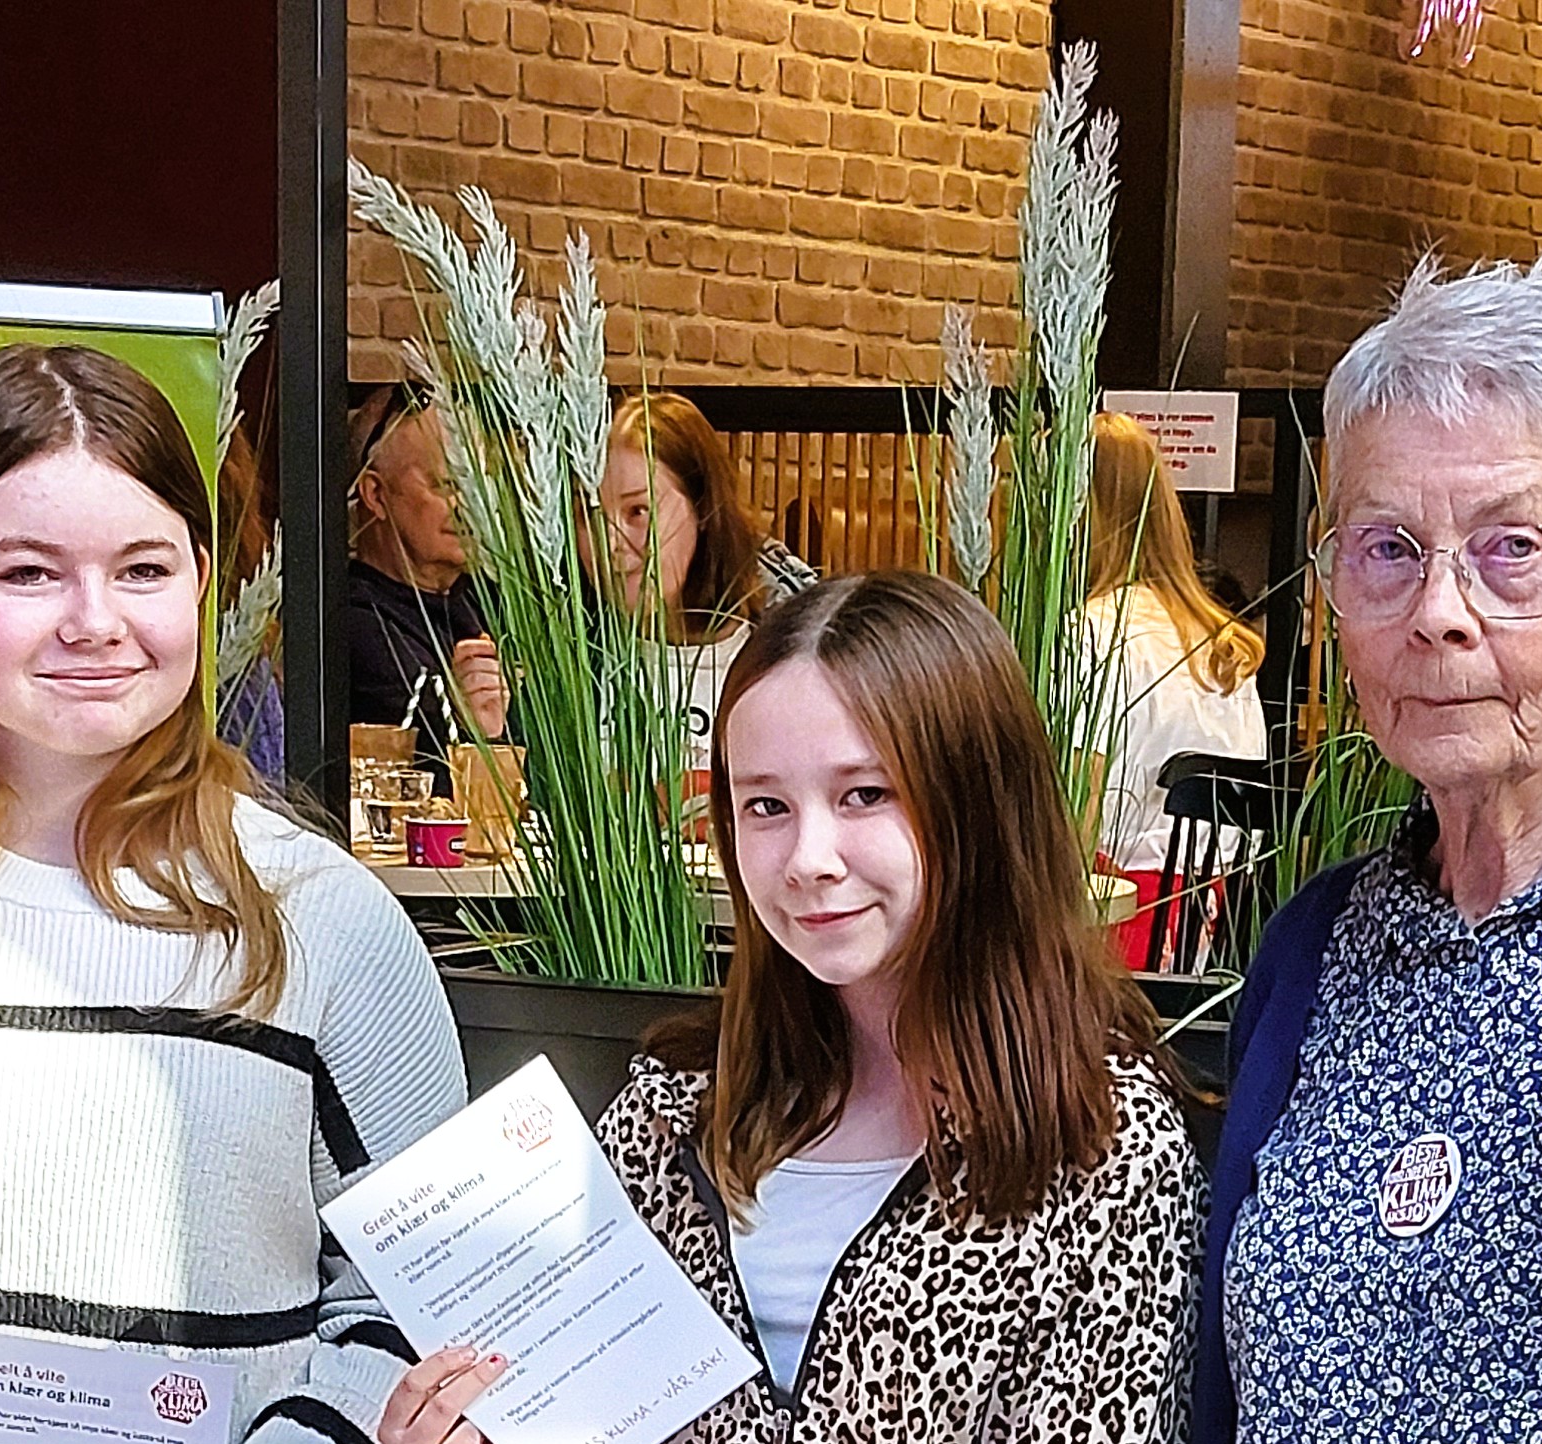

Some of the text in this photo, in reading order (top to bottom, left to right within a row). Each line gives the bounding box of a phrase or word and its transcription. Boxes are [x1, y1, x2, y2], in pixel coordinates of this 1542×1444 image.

[1383, 1176, 1447, 1209] KLIMA
[375, 1173, 485, 1253] om klær og klima
[23, 1365, 32, 1379] å
[36, 1368, 66, 1384] vite
[9, 1380, 44, 1398] klær
[46, 1390, 66, 1403] og
[69, 1389, 111, 1408] klima
[605, 1404, 652, 1439] KLIMA
[663, 1374, 694, 1399] VÅR
[691, 1347, 727, 1379] SAK!
